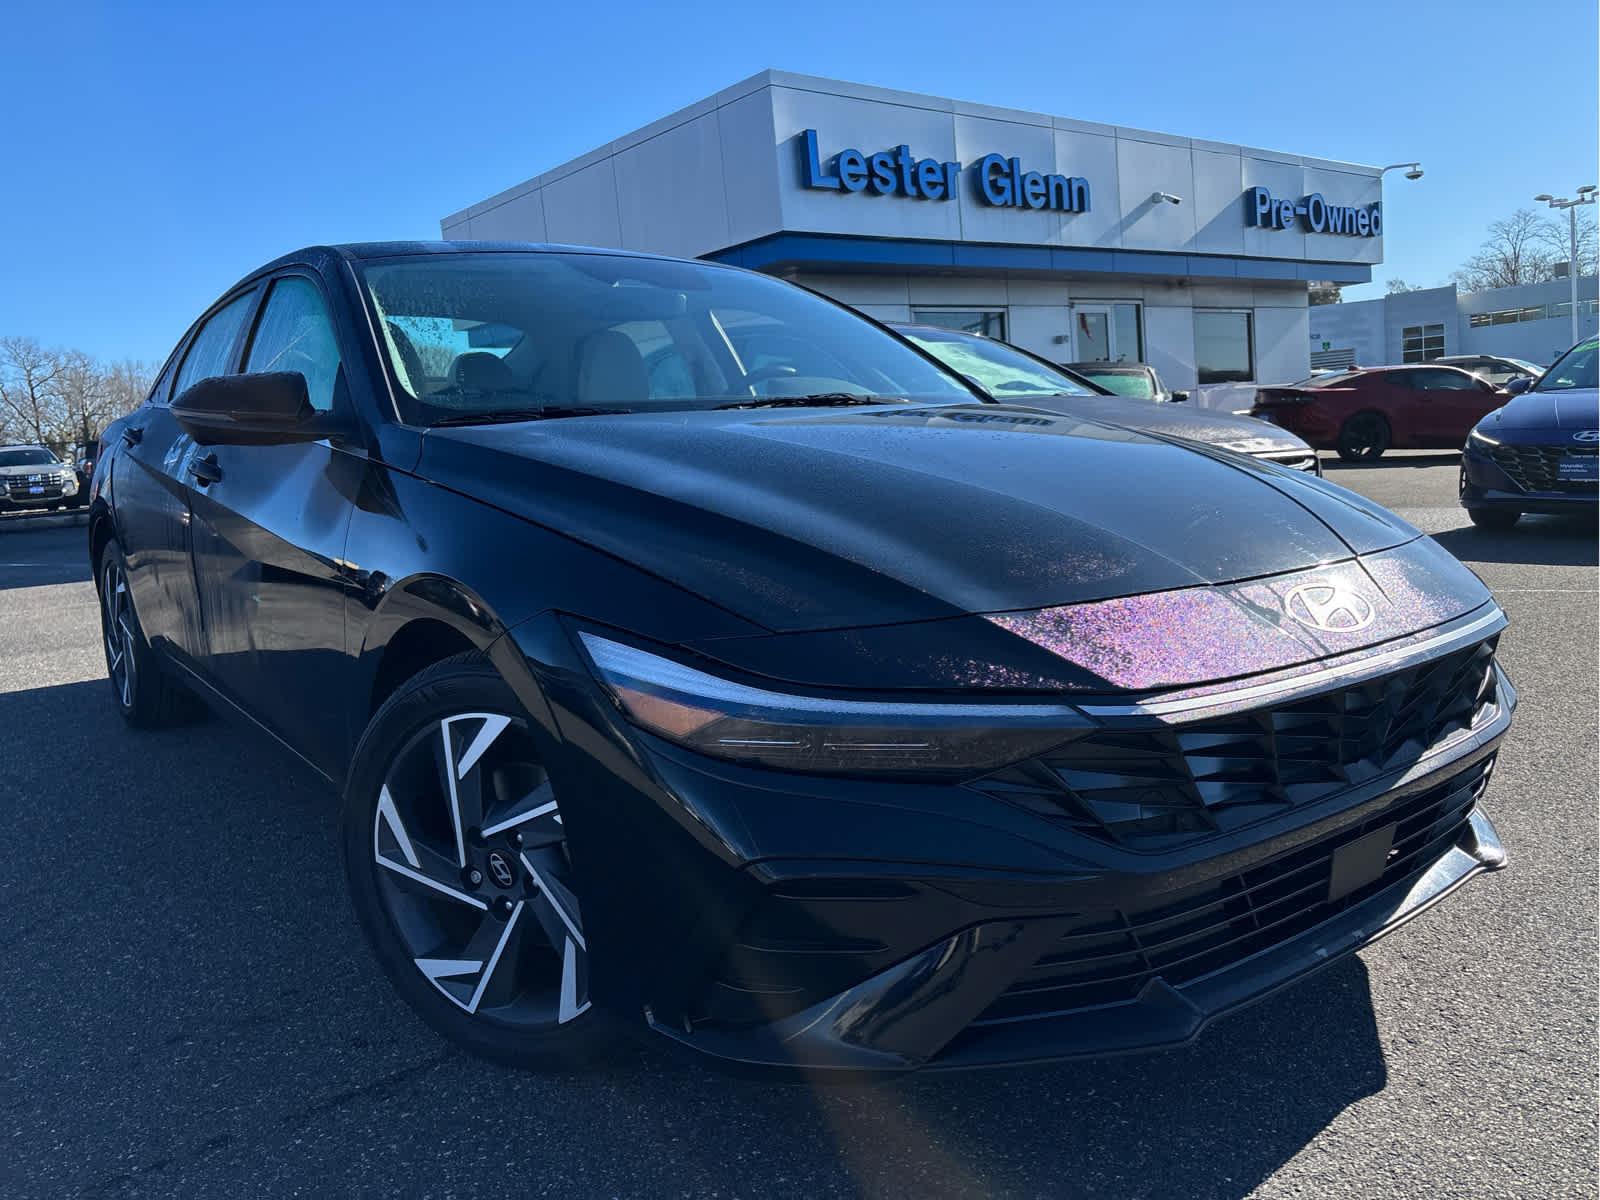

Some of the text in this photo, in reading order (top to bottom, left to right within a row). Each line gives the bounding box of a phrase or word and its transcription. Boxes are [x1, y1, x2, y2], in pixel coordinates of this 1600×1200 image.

[800, 129, 1091, 213] Lester Glenn
[1247, 186, 1382, 237] Pre-Owned
